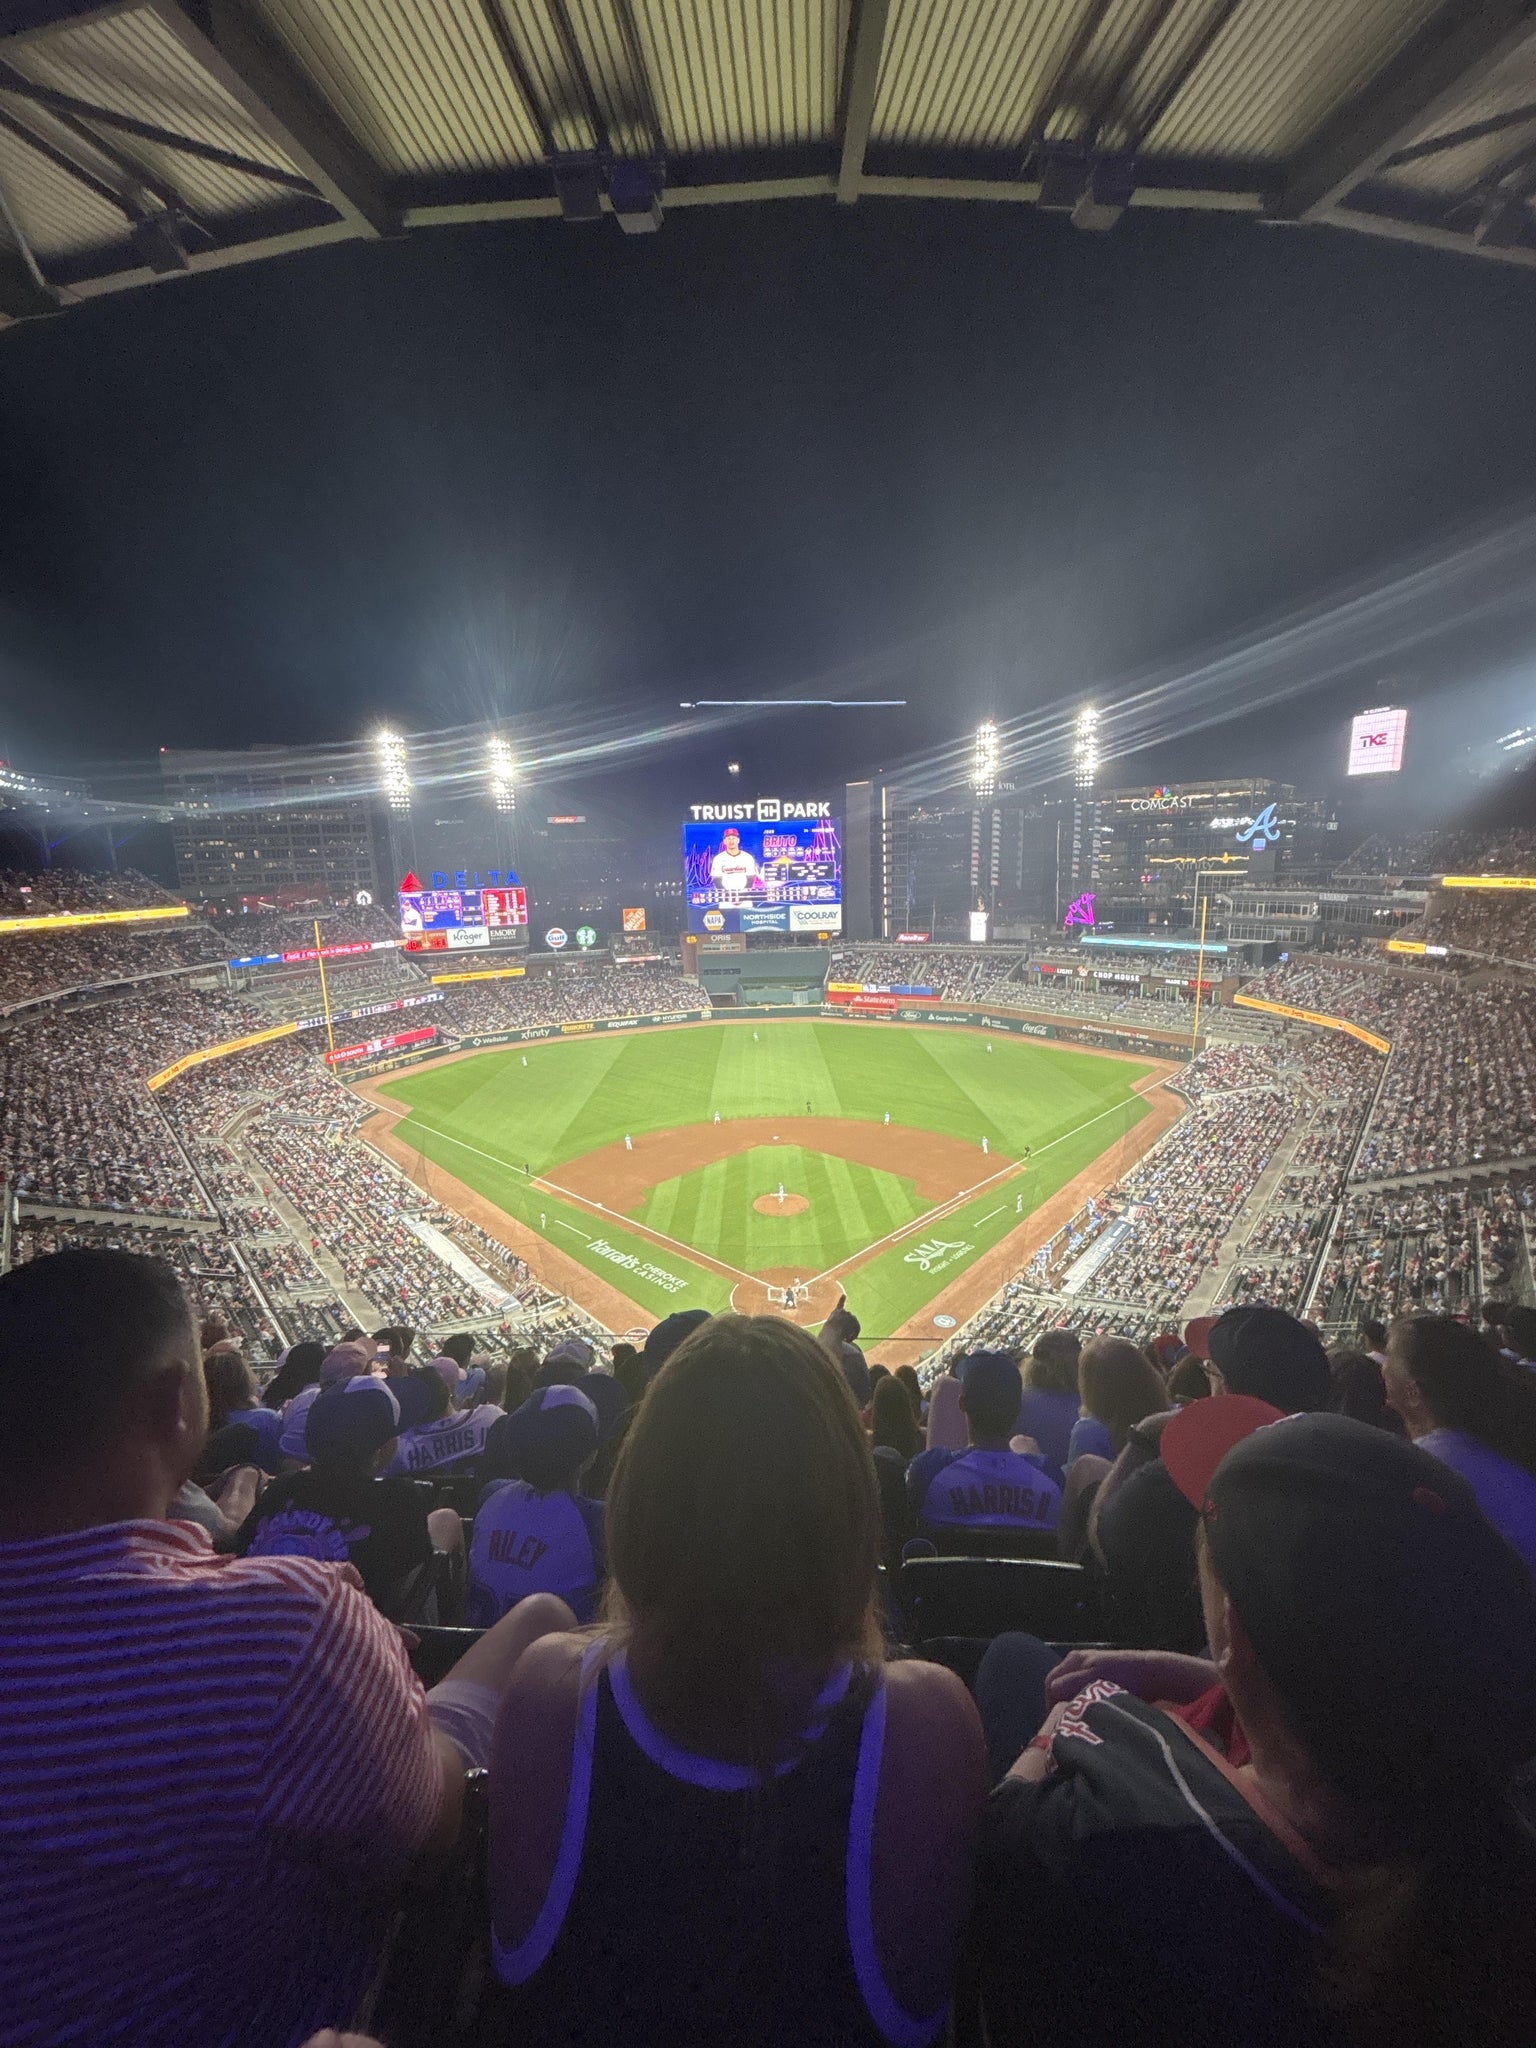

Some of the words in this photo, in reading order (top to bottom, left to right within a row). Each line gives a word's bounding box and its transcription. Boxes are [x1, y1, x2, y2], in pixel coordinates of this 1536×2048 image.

[1360, 733, 1387, 747] TKE
[1131, 798, 1193, 811] COMCAST
[690, 804, 754, 821] TRUIST
[784, 802, 831, 818] PARK
[763, 834, 797, 848] BRITO
[431, 869, 521, 889] DELTA
[706, 915, 722, 925] NAPA
[743, 913, 787, 922] NORTHSIDE
[797, 911, 839, 920] COOLRAY
[453, 929, 483, 945] Kroger
[489, 927, 517, 937] EMORY
[547, 934, 566, 942] Gulf
[710, 934, 732, 942] ORIS
[1056, 967, 1072, 975] LIGHT
[1093, 971, 1113, 979] CHOP
[1114, 973, 1140, 982] HOUSE
[863, 995, 879, 1003] State
[607, 1019, 638, 1029] EQUIFAX
[521, 1028, 550, 1040] xfinity
[632, 1265, 681, 1295] CASINOS
[641, 1262, 690, 1289] CHEROKEE
[407, 1428, 475, 1472] HARRIS
[950, 1484, 1034, 1519] HARRIS
[488, 1529, 546, 1571] RILEY
